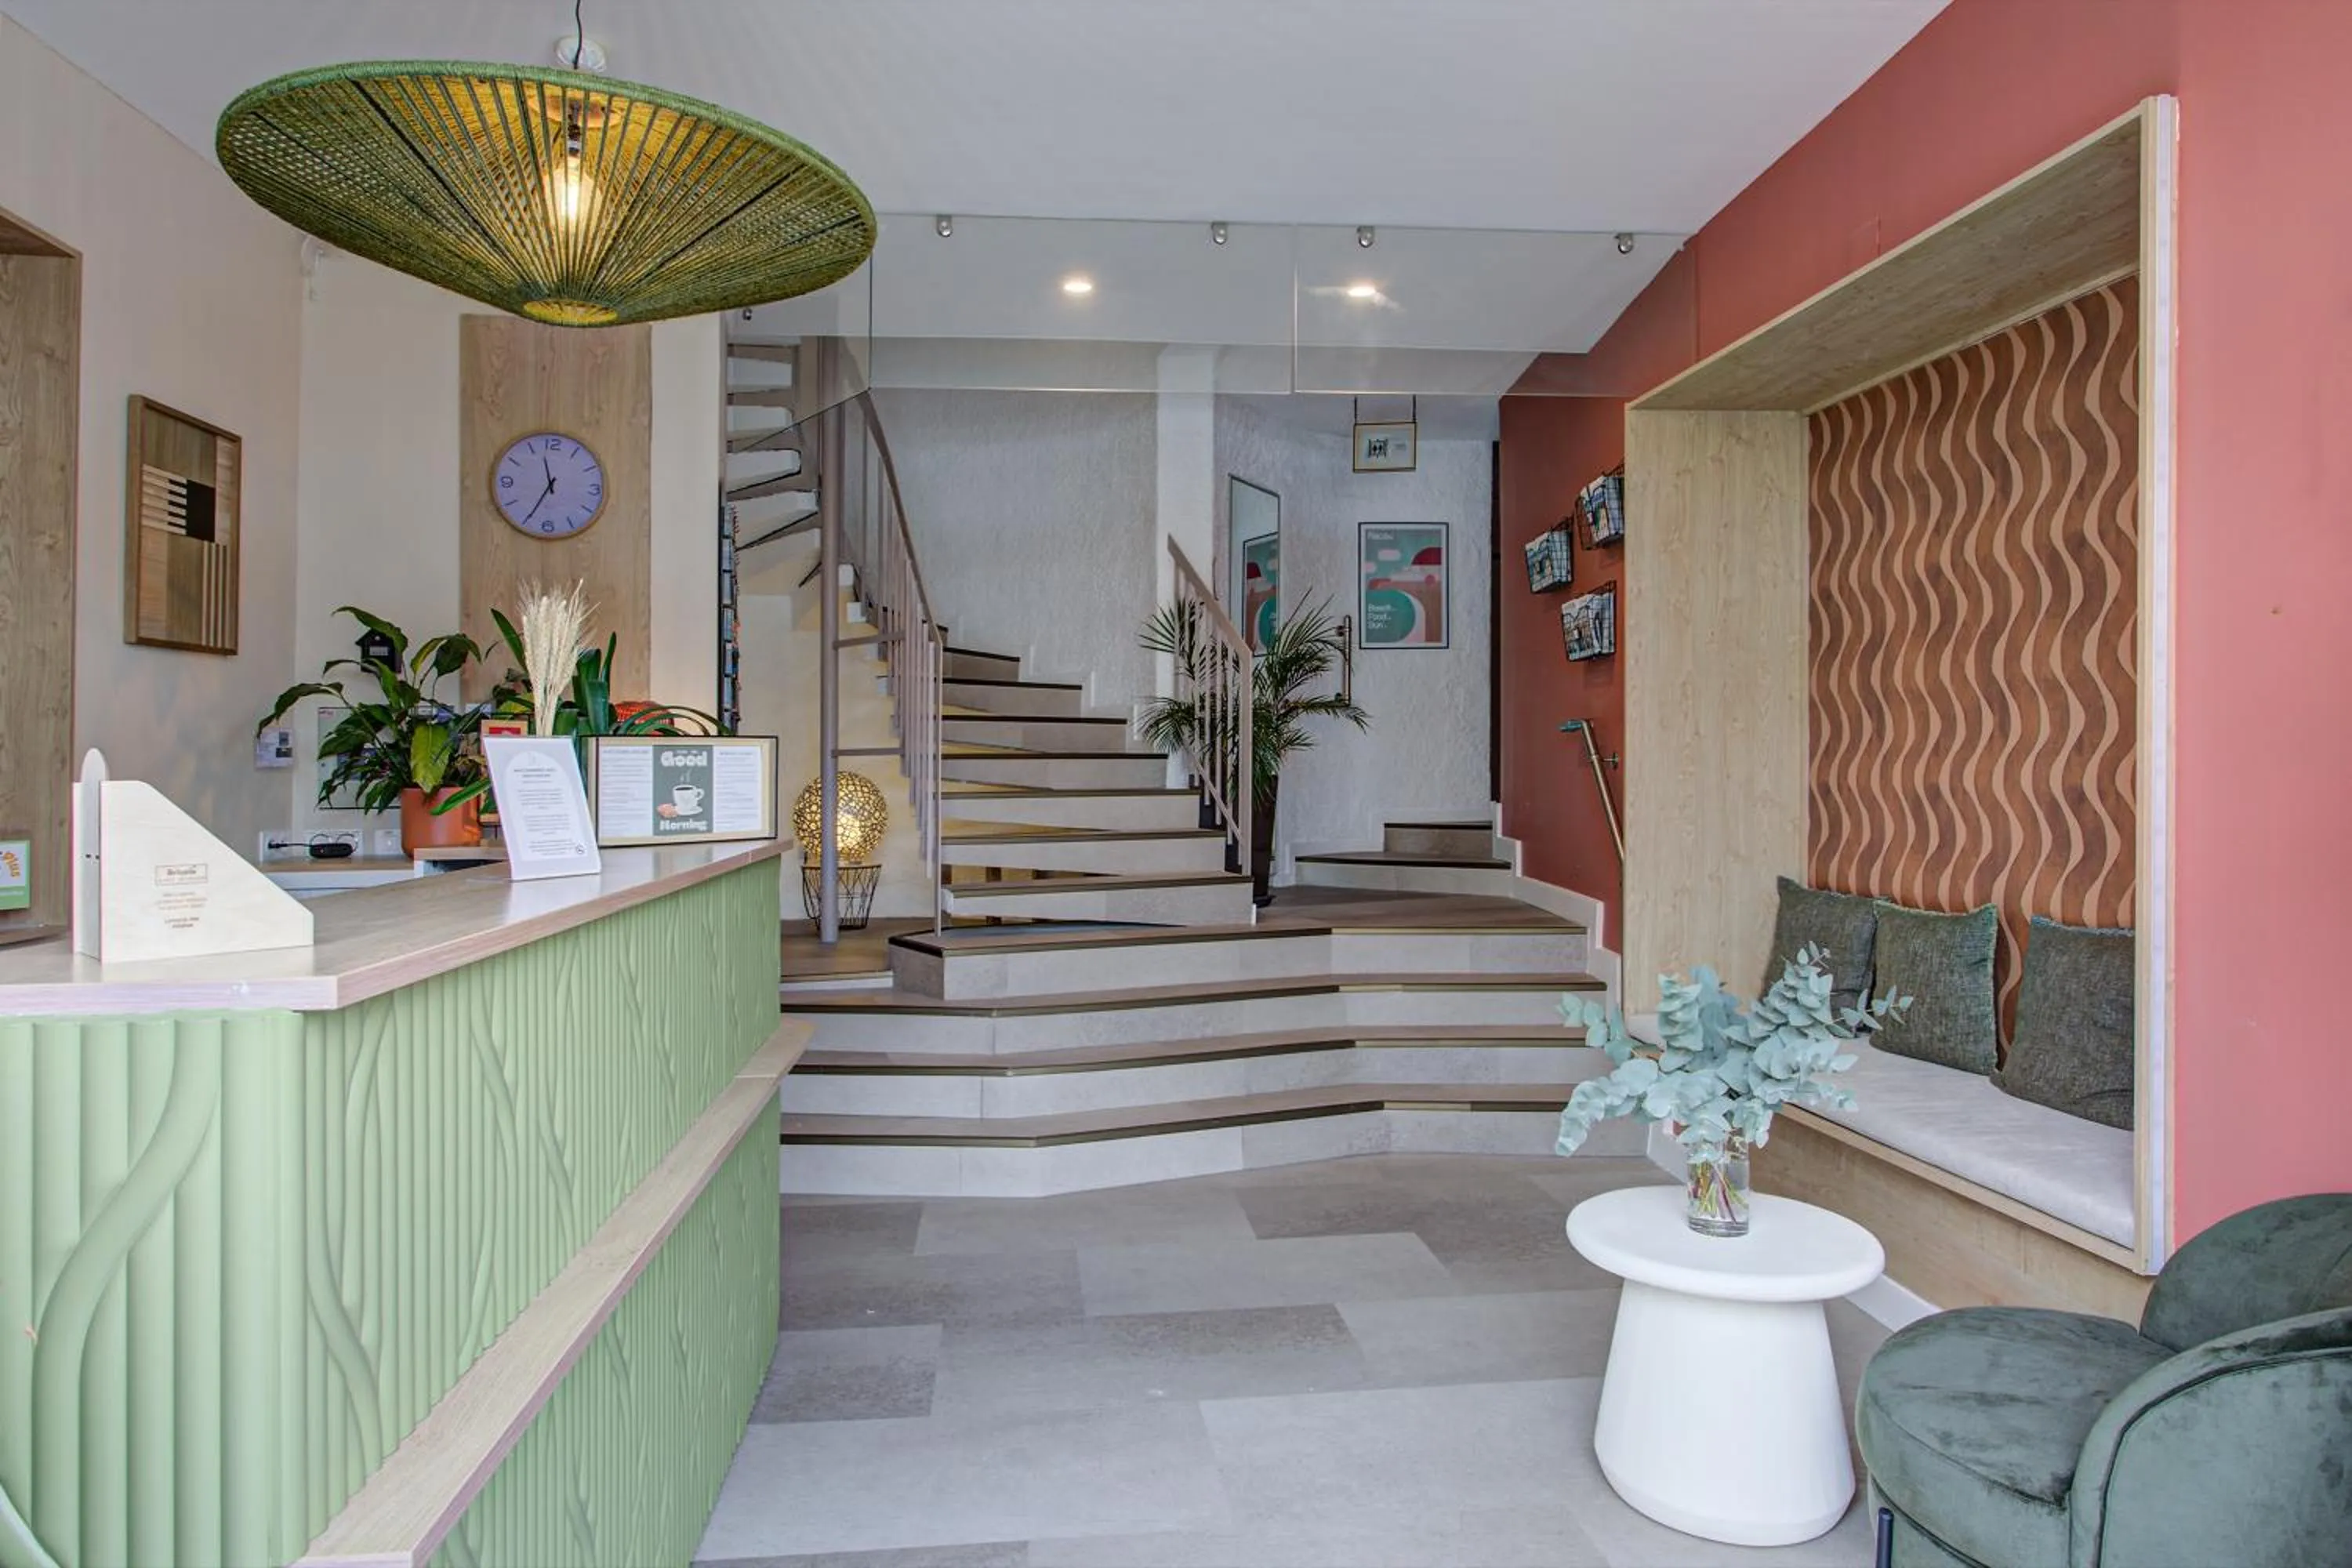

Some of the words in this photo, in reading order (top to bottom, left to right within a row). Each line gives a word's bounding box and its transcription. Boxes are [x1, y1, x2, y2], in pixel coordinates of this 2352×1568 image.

[544, 438, 562, 451] 12
[500, 476, 514, 488] 9
[589, 484, 601, 495] 3
[541, 520, 554, 533] 6
[660, 750, 708, 767] Good
[659, 819, 709, 831] Morning
